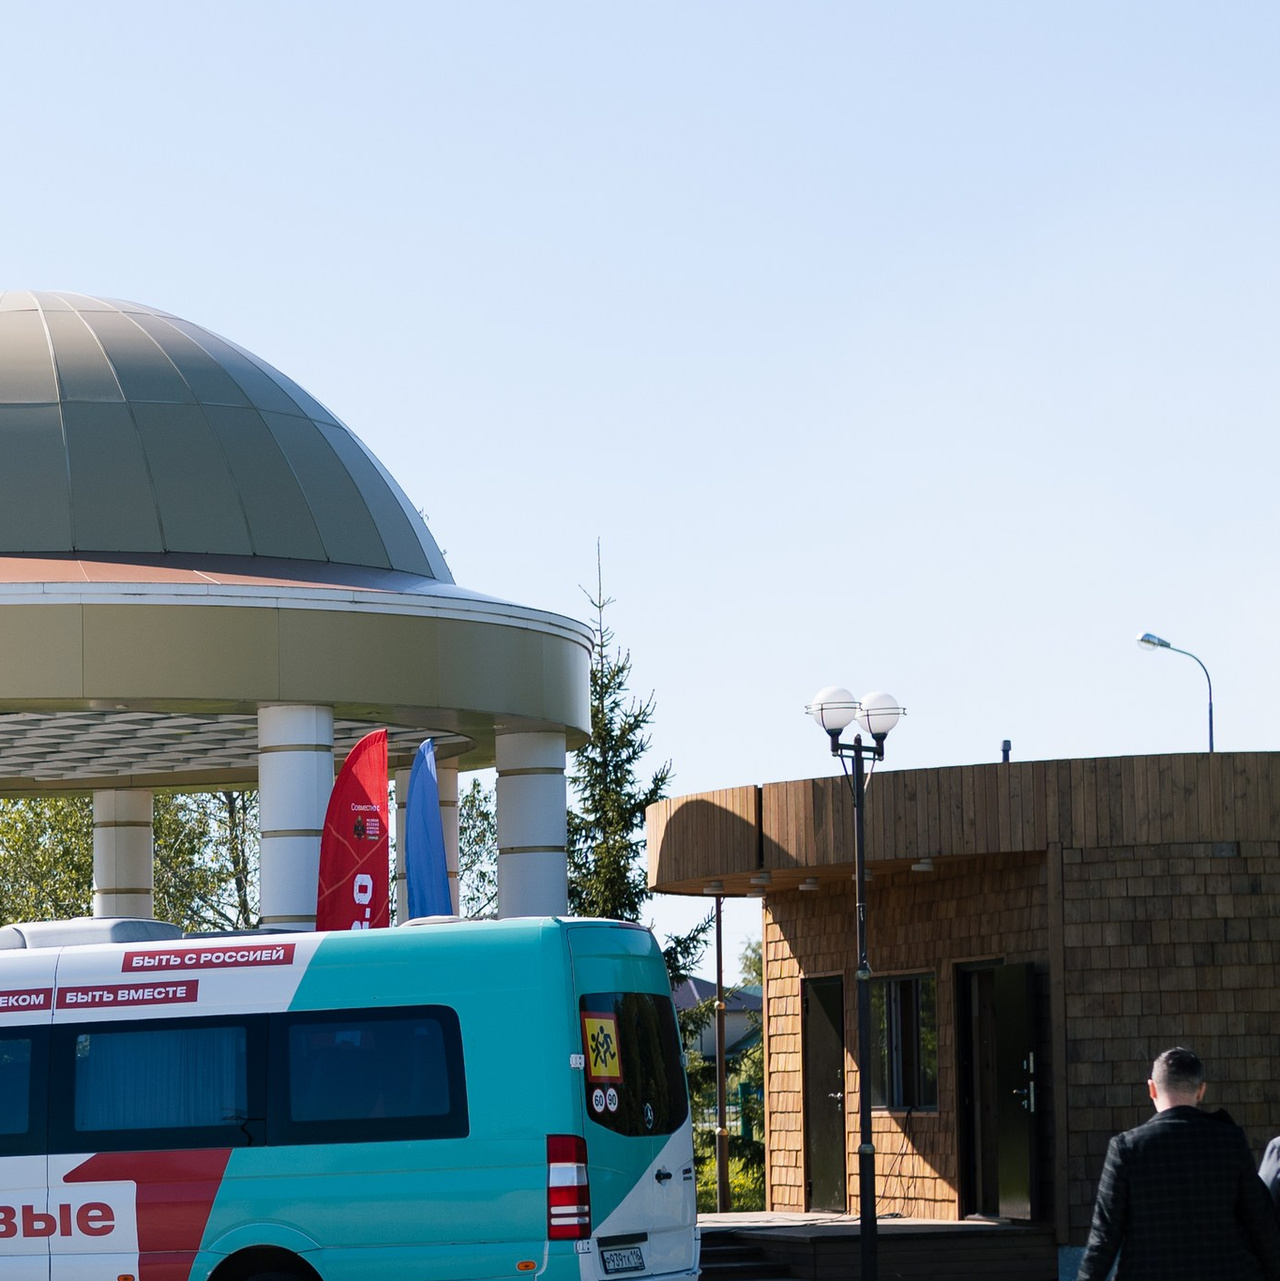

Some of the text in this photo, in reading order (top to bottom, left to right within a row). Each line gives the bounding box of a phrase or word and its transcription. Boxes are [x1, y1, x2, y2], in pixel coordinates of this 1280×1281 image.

[132, 946, 285, 967] БЫТЬ С РОССИЕЙ
[65, 986, 187, 1003] БЫТЬ ВМЕСТЕ
[595, 1094, 604, 1107] 60
[608, 1093, 617, 1106] 90
